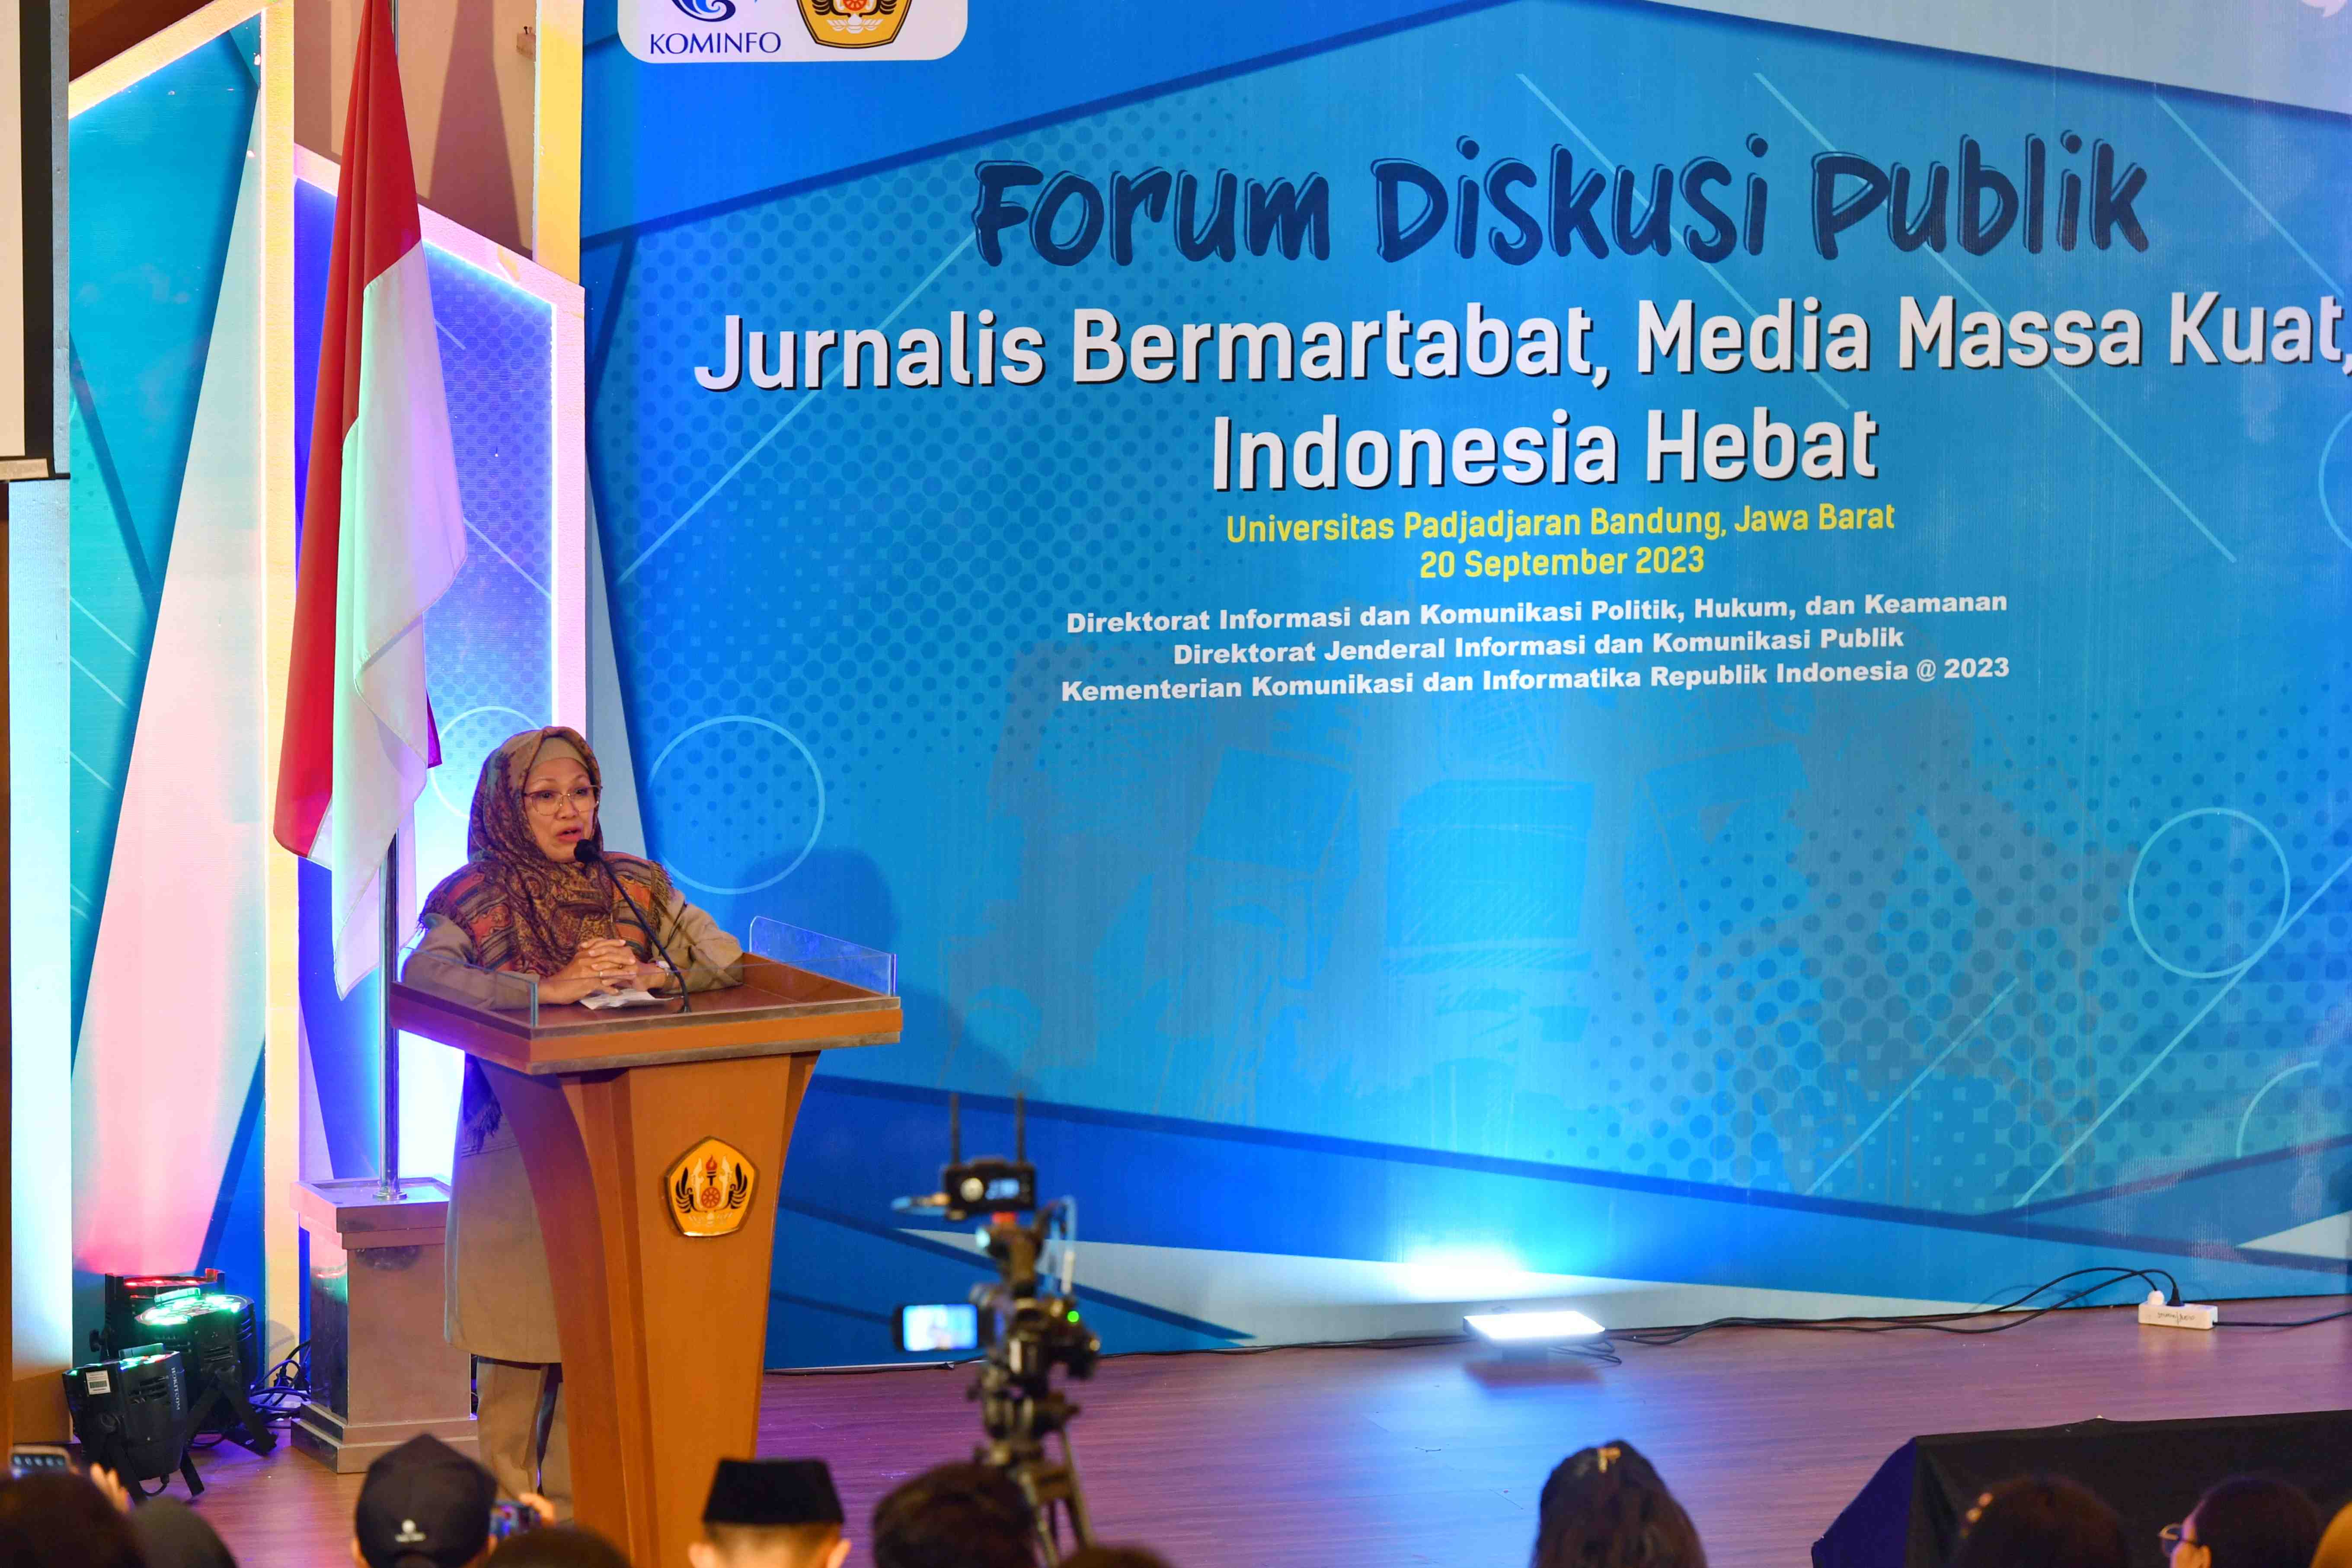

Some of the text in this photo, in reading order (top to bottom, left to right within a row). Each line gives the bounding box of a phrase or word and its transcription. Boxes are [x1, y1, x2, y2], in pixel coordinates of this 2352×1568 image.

[650, 32, 781, 54] KOMINFO
[695, 310, 1045, 392] Jurnalis
[1074, 303, 1609, 390] Bermartabat,
[1639, 297, 1869, 374] Media
[1900, 296, 2142, 370] Massa
[1214, 407, 1878, 492] Indonesia Hebat
[1227, 502, 1895, 543] Universitas Padjadjaran Bandung, Jawa Barat
[1421, 546, 1704, 581] 20 September 2023
[1067, 593, 2007, 633] Direktorat Informasi dan Komunikasi Politik, Hukum, dan Keamanan
[1174, 627, 1904, 664] Direktorat Jenderal Informasi dan Komunikasi Publik
[1062, 657, 2010, 702] Kementerian Komunikasi dan Informatika Republik Indonesia @ 2023
